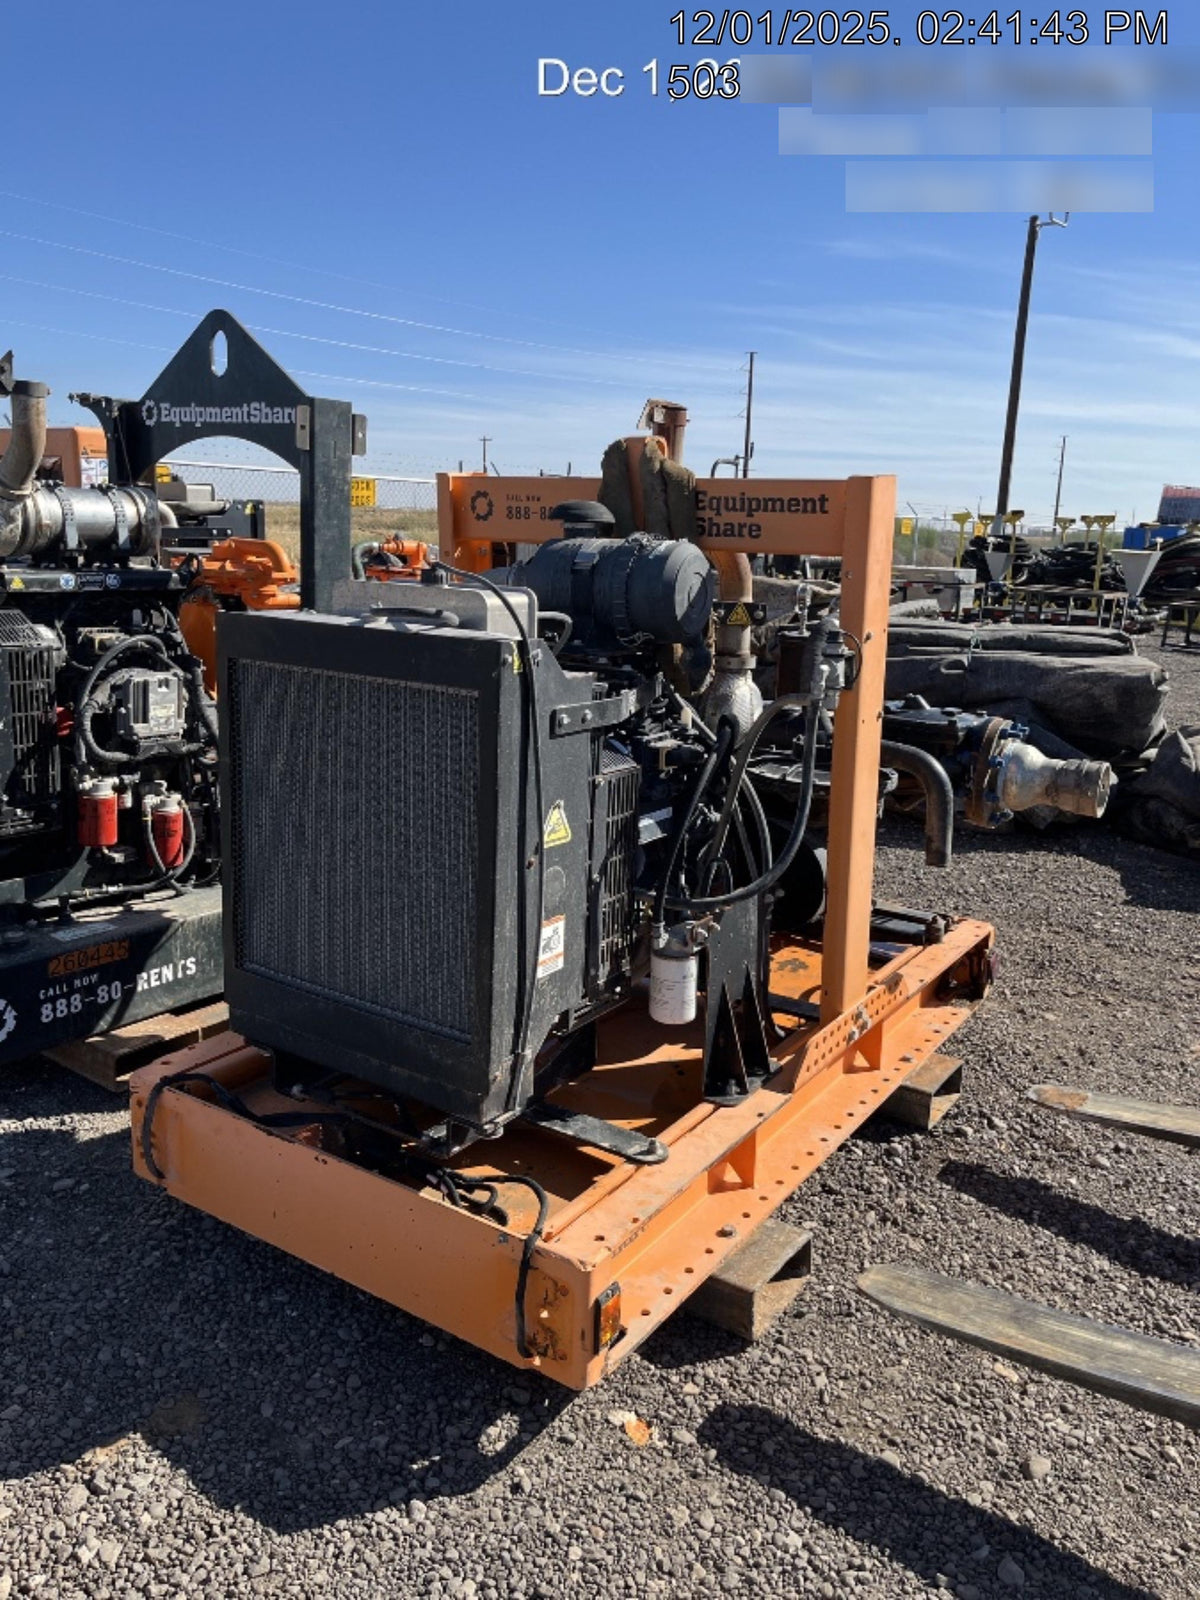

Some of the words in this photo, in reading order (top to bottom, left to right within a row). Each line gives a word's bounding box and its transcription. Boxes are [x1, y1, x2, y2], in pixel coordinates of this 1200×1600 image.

[696, 490, 829, 517] Equipment
[697, 517, 762, 539] Share
[39, 983, 68, 1000] CALL
[74, 972, 99, 989] NOW
